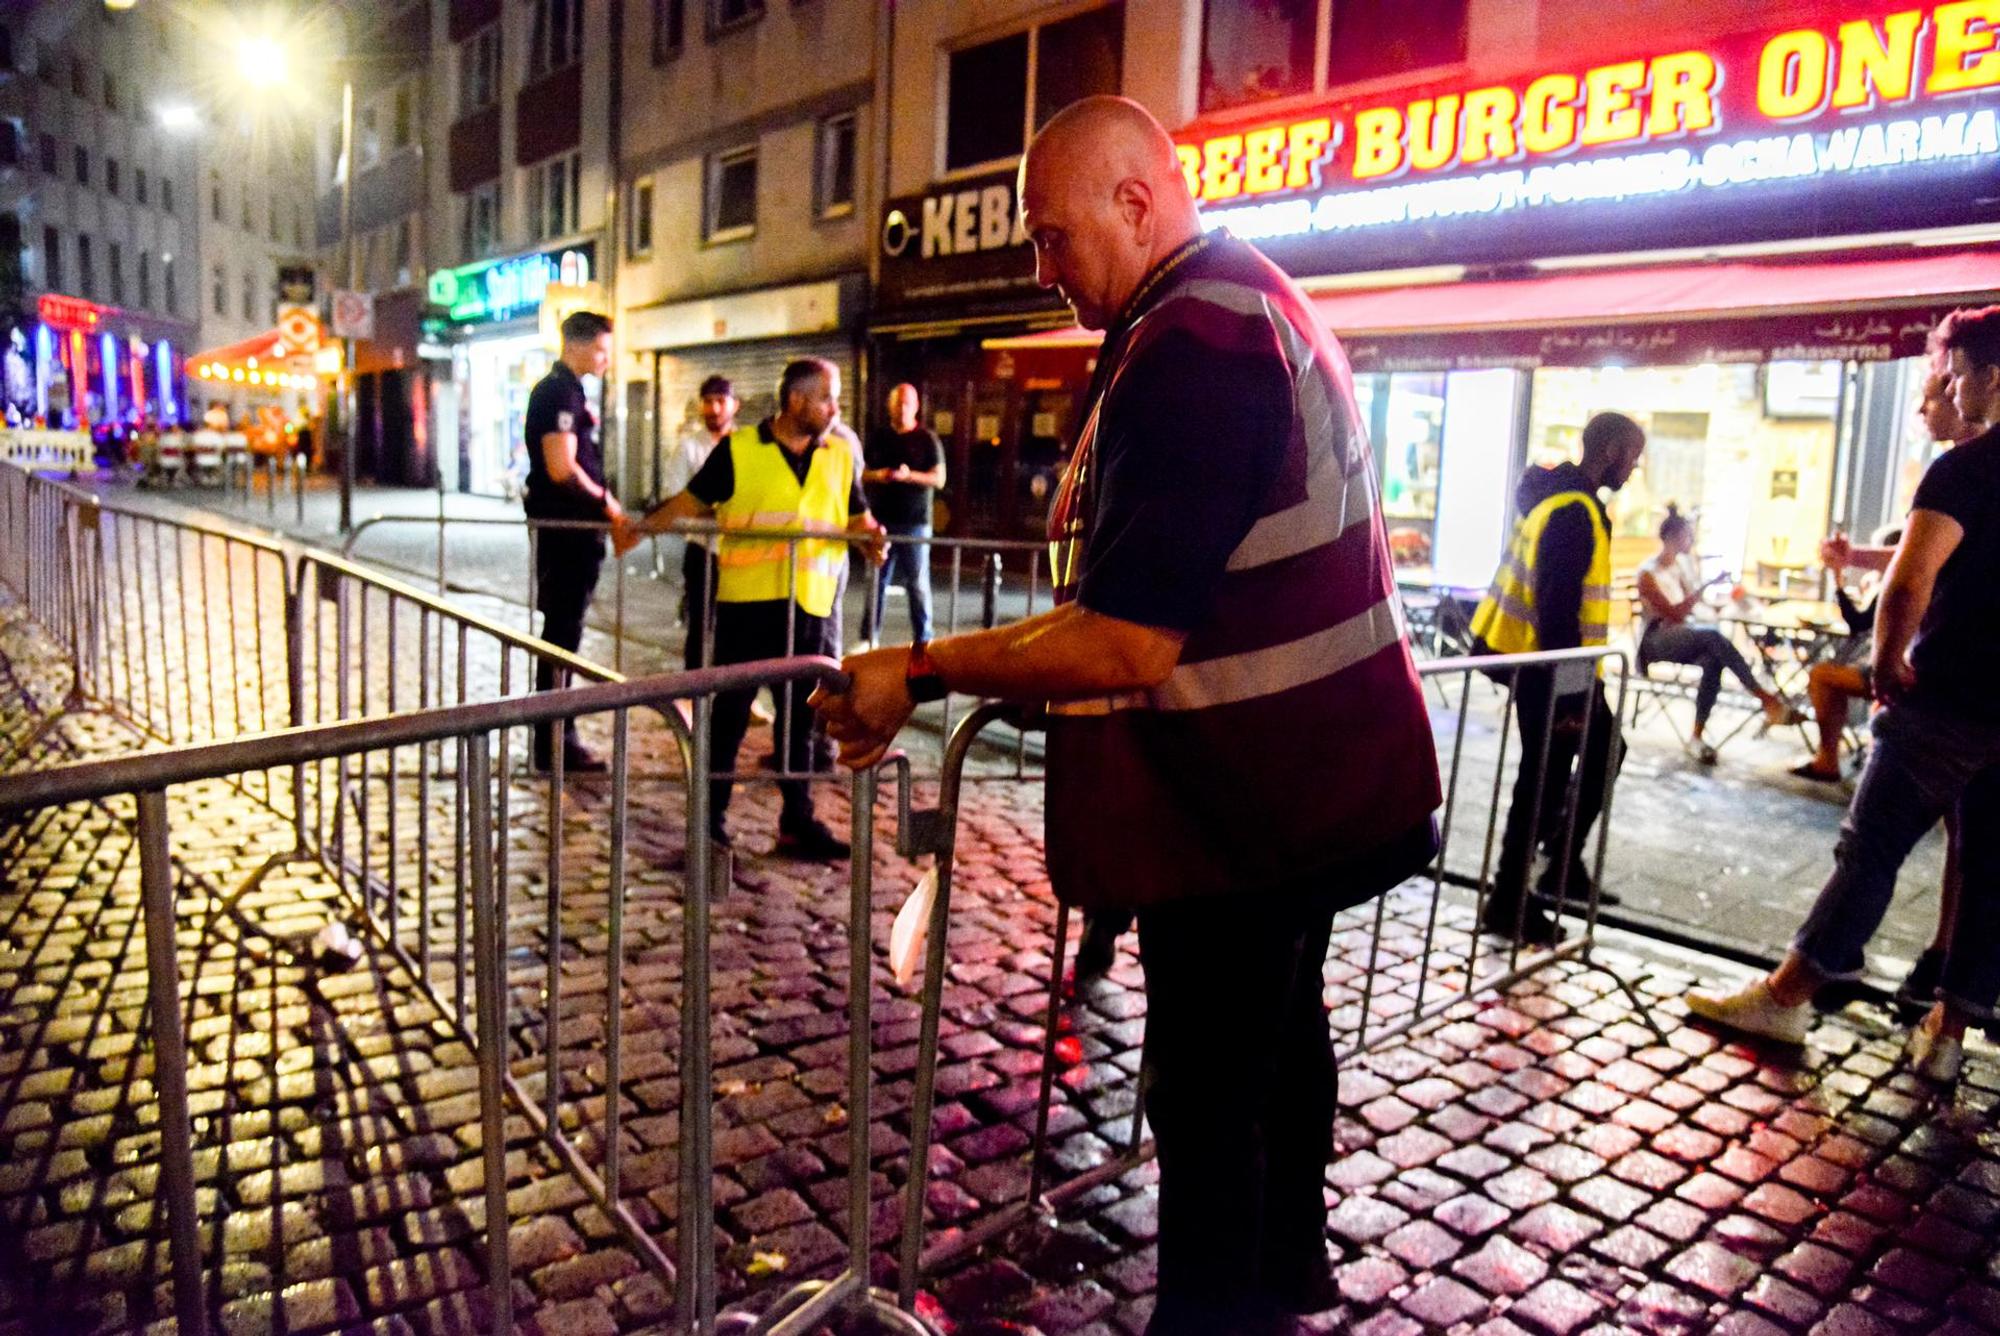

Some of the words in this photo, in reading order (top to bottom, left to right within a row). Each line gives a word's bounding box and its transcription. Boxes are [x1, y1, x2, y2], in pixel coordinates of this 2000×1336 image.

[1175, 117, 1331, 202] BEEF
[1352, 50, 1716, 180] BURGER
[1756, 0, 2000, 118] ONE
